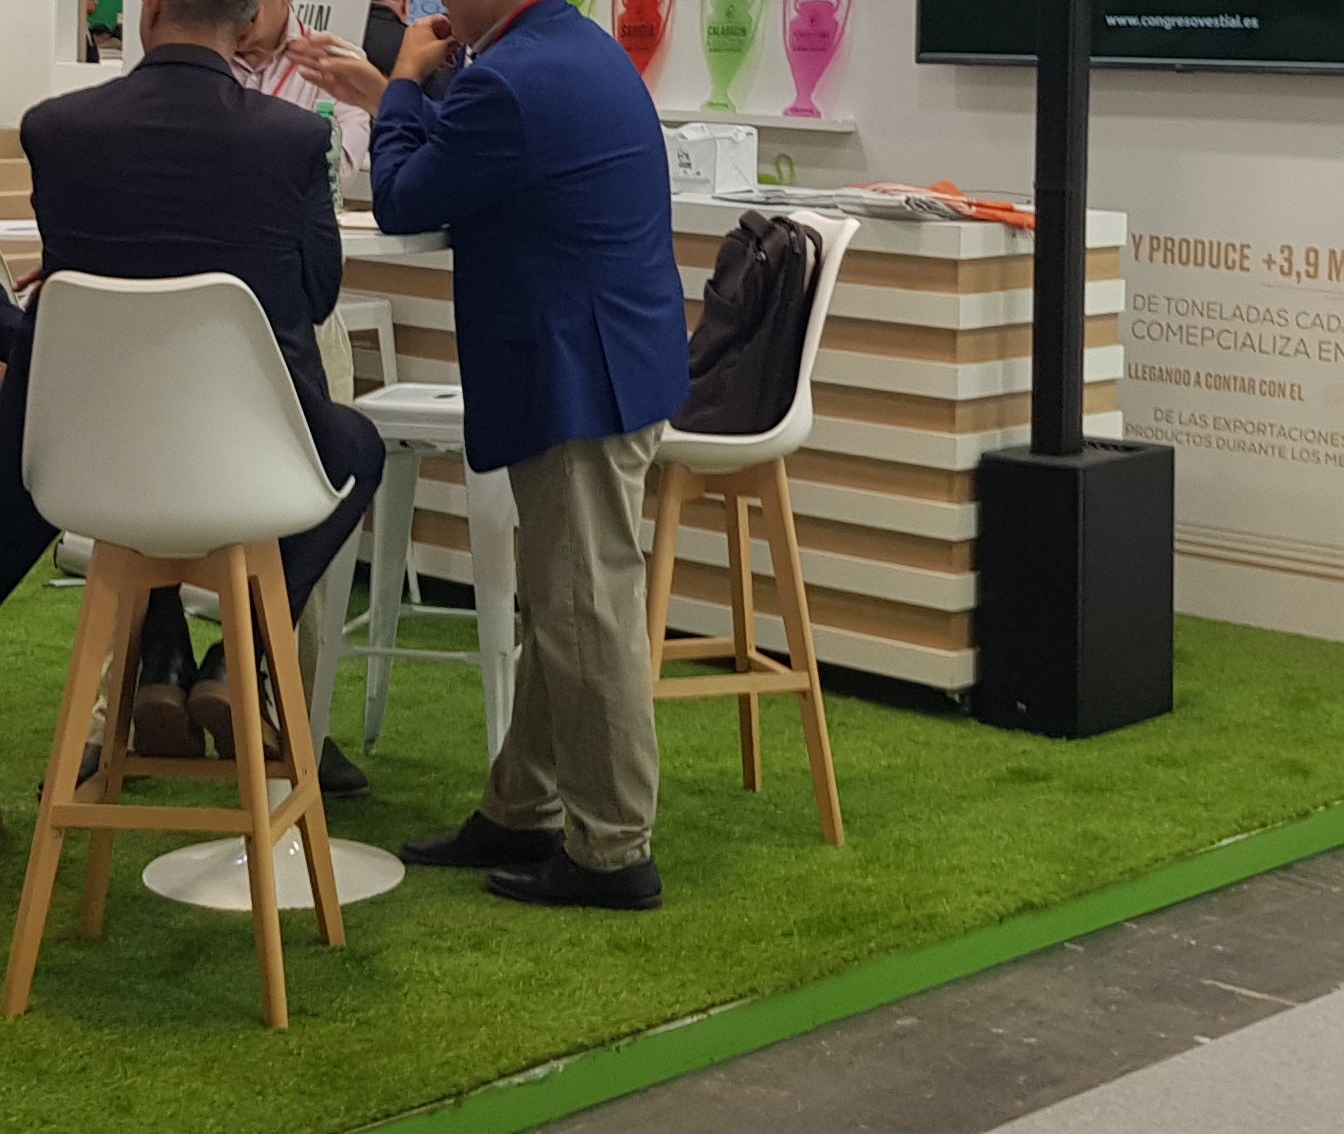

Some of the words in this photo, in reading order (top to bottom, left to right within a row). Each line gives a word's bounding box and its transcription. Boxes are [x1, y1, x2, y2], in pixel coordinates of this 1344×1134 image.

[1130, 233, 1144, 262] Y
[1149, 234, 1252, 273] PRODUCE
[1261, 243, 1320, 284] +3,9
[1132, 293, 1159, 314] DE
[1164, 295, 1290, 328] TONELADAS
[1131, 319, 1311, 360] COMEPCIALIZA
[1127, 363, 1191, 387] LLEGANDO
[1193, 370, 1202, 388] A
[1204, 371, 1256, 396] CONTAR
[1259, 379, 1286, 400] CON
[1289, 383, 1305, 403] EL
[1153, 406, 1174, 425] DE
[1178, 410, 1208, 430] LAS
[1124, 422, 1213, 448] PRODUCTOS
[1215, 431, 1289, 460] DURANTE
[1290, 446, 1321, 465] LOS
